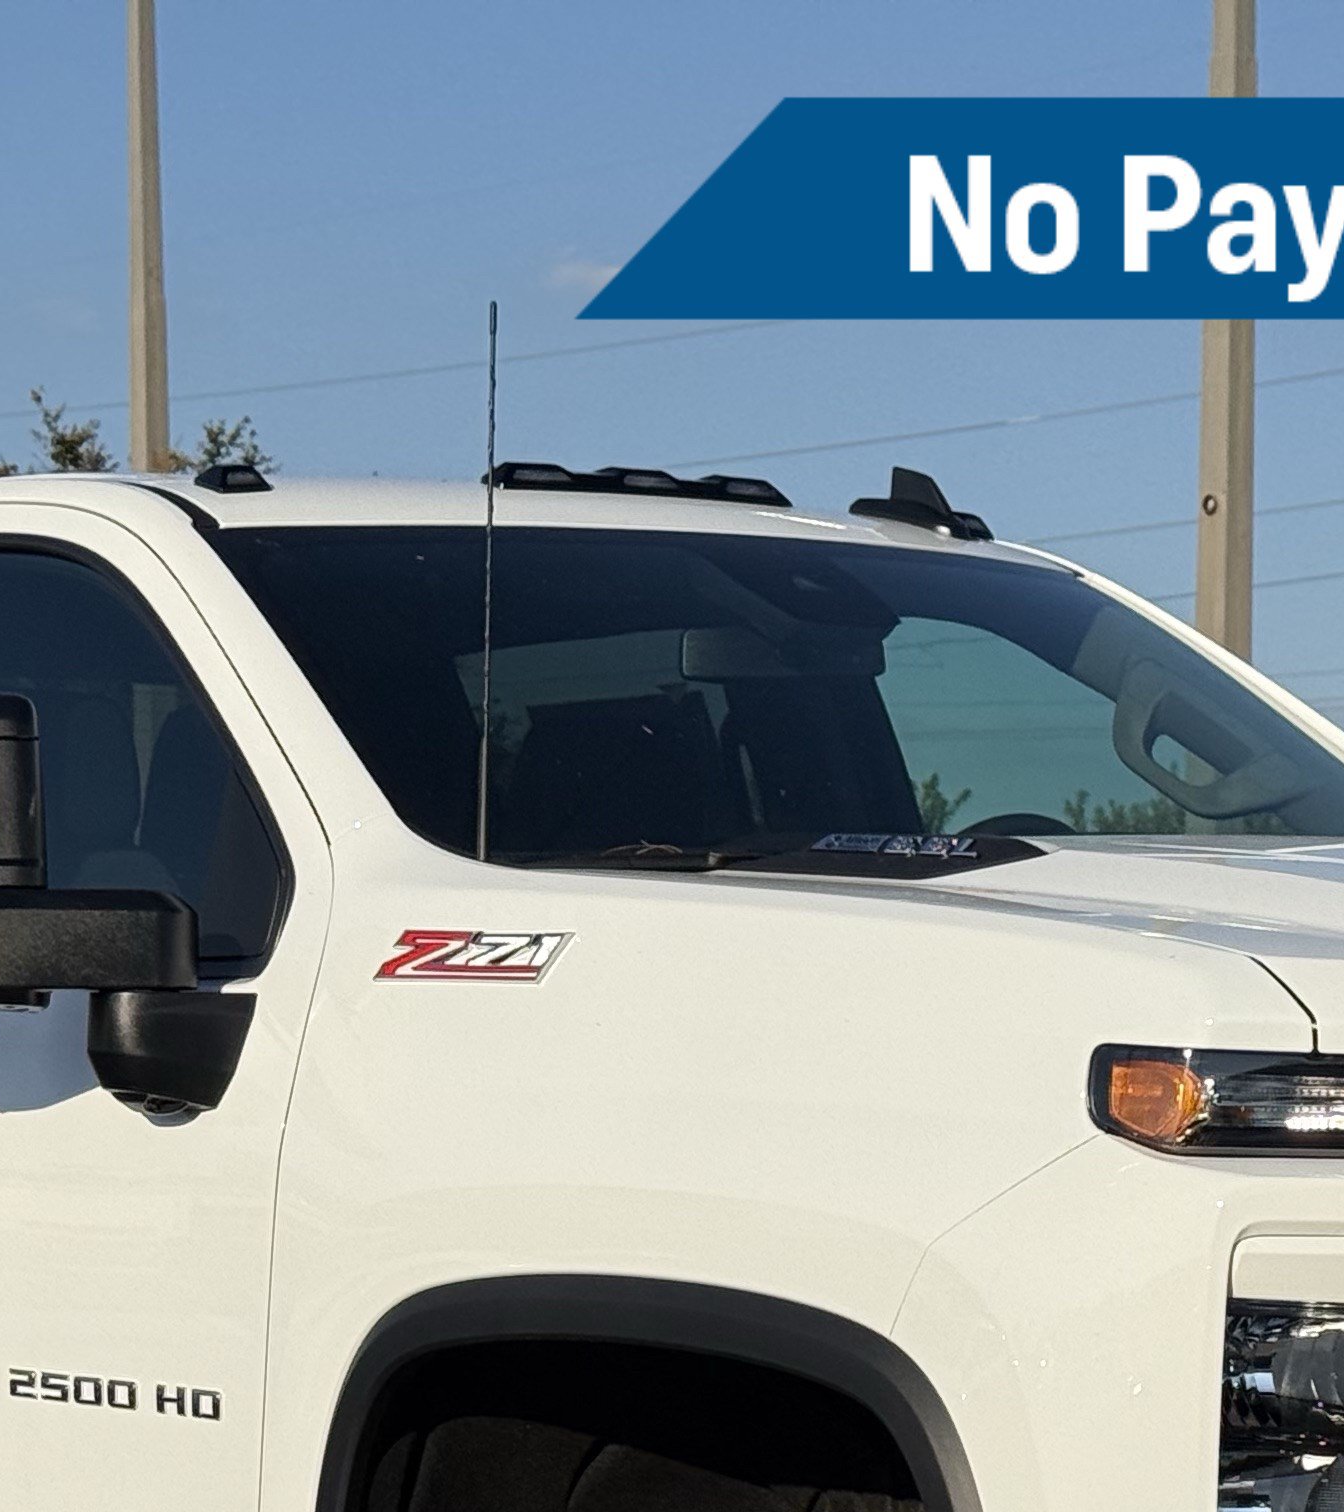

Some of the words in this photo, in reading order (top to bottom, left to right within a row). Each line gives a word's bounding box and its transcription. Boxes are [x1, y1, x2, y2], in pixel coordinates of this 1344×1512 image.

[373, 929, 575, 984] Z71
[8, 1367, 139, 1411] 2500
[155, 1383, 222, 1422] HD
